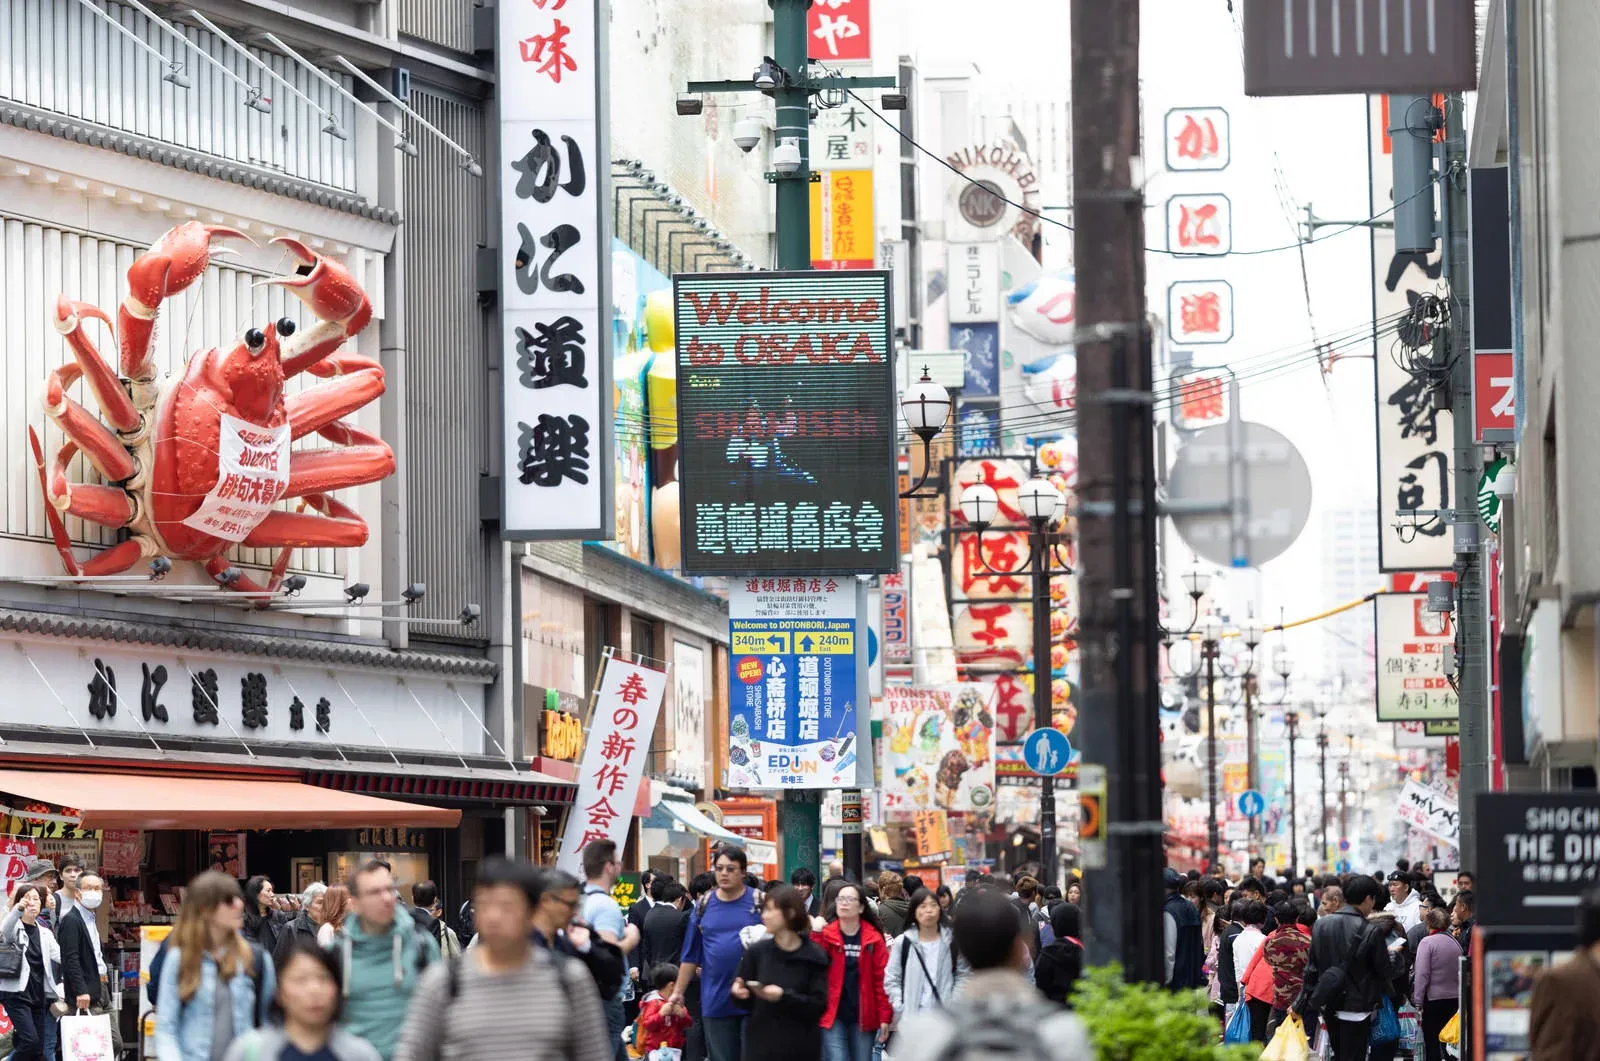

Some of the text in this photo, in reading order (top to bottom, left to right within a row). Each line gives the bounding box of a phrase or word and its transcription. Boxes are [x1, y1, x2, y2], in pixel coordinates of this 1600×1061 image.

[813, 0, 861, 56] や
[511, 128, 589, 487] かに道楽
[684, 287, 879, 325] Welcome
[686, 332, 884, 366] to OSAKA
[745, 578, 839, 593] 道頓堀商店会
[733, 621, 850, 630] Welcome to DOTONBORI, Japan
[735, 635, 765, 646] 340m
[819, 635, 849, 646] 240m
[740, 668, 762, 679] OPEN!
[741, 661, 758, 670] NEW
[746, 685, 754, 707] STORE
[889, 699, 952, 714] PARFAT
[768, 755, 817, 774] EDION
[1504, 833, 1555, 863] THE
